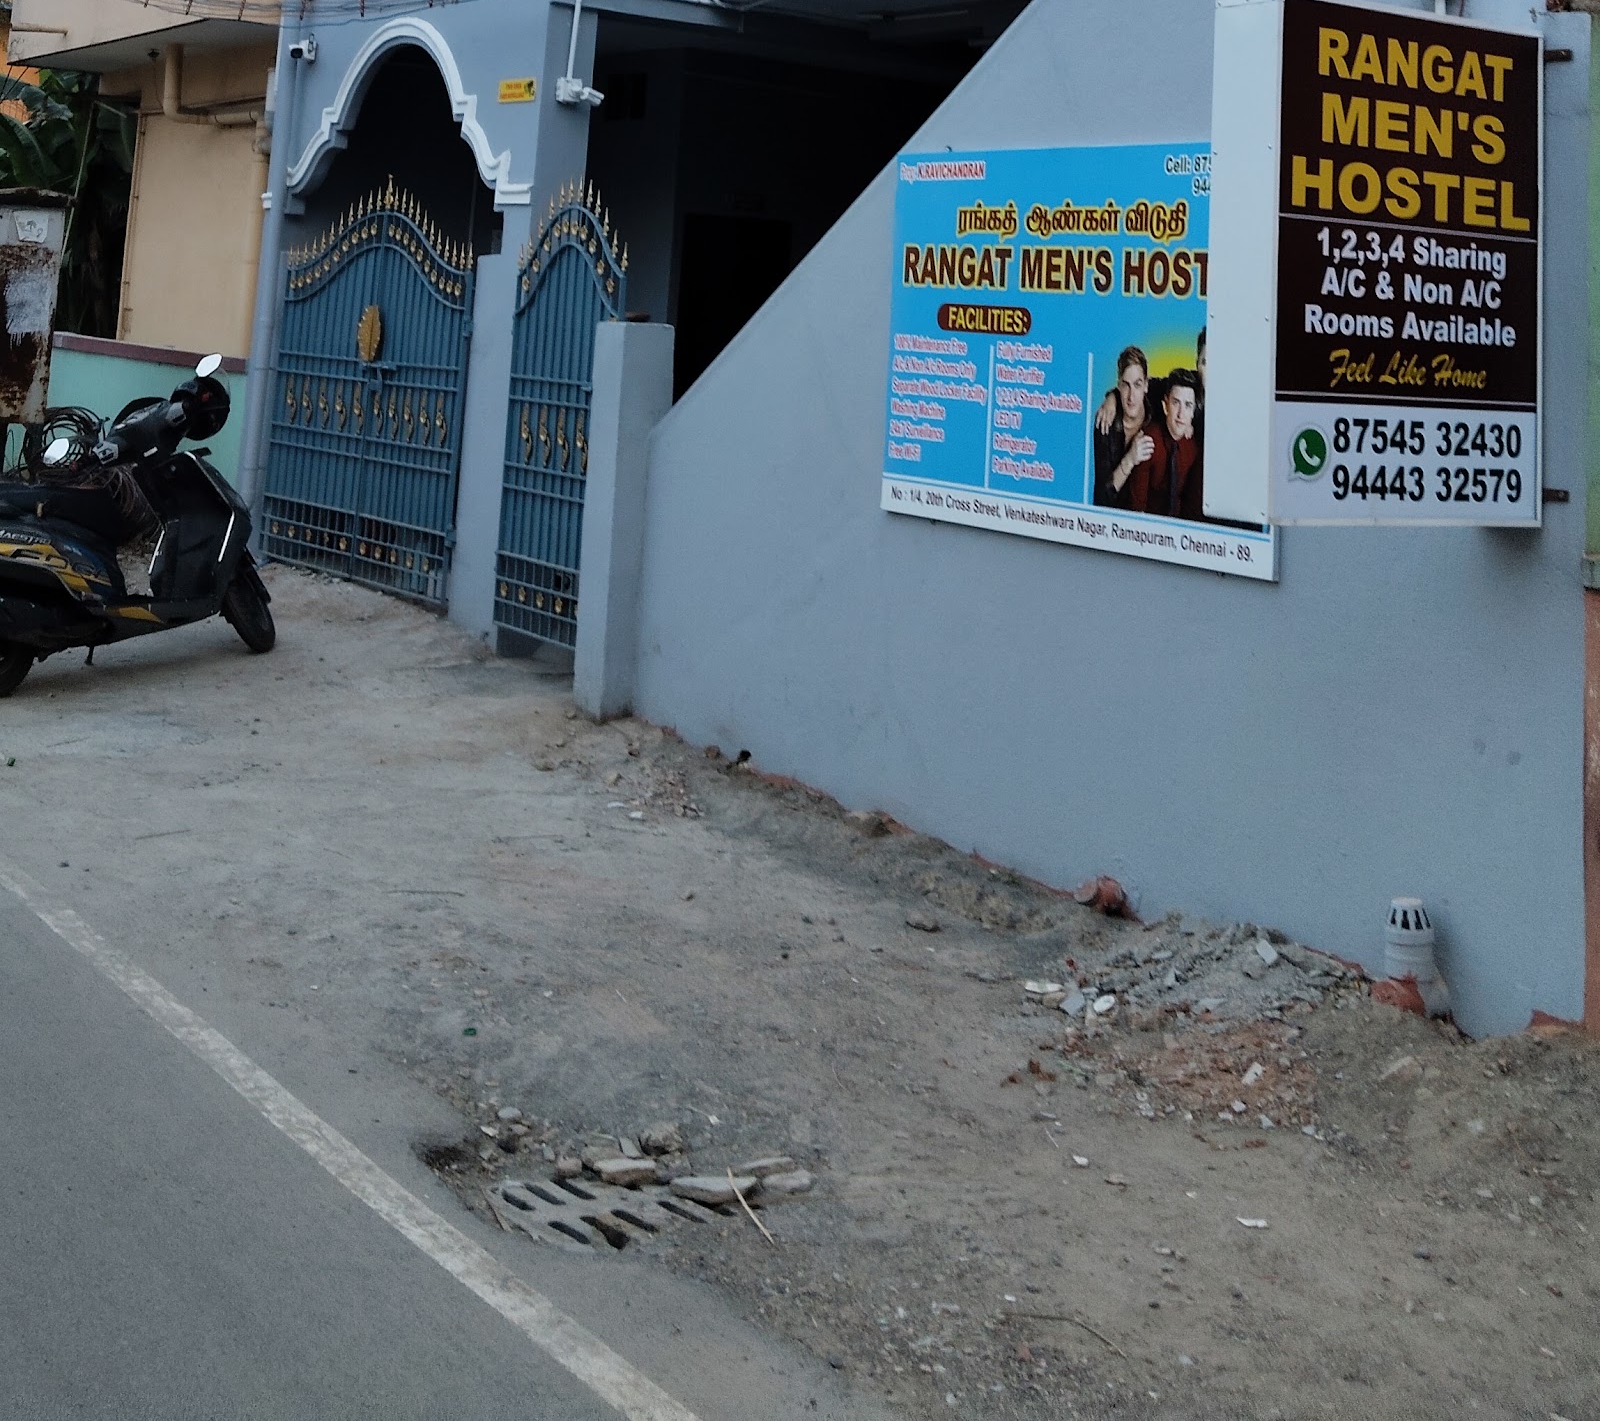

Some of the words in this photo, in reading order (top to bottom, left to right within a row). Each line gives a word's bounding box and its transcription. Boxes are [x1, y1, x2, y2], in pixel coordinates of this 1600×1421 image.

[1318, 27, 1513, 102] RANGAT
[1322, 92, 1506, 165] MEN'S
[1165, 156, 1192, 173] Cell:
[1291, 155, 1530, 231] HOSTEL
[957, 201, 1018, 237] ரங்கத்
[1026, 201, 1121, 237] ஆண்கள்
[1125, 201, 1187, 242] விடுதி
[904, 246, 1012, 287] RANGAT
[1020, 249, 1112, 292] MEN'S
[1317, 227, 1405, 268] 1,2,3,4
[1413, 236, 1507, 280] Sharing
[1321, 267, 1366, 298] A/C
[1375, 271, 1395, 300] &
[1404, 274, 1453, 305] Non
[1460, 279, 1502, 309] A/C
[948, 306, 1028, 333] FACILITIES:
[1305, 304, 1394, 339] Rooms
[1401, 312, 1517, 347] Available
[1329, 349, 1375, 387] Feel
[1379, 350, 1427, 385] Like
[1431, 354, 1487, 389] Home
[1333, 418, 1425, 455] 87545
[1435, 422, 1521, 458] 32430
[1332, 465, 1425, 501] 94443
[1435, 467, 1521, 503] 32579
[926, 490, 944, 508] 20th
[946, 495, 971, 512] Cross
[1004, 504, 1074, 530] Venkateshwara
[1111, 523, 1177, 551] Ramapuram,
[1180, 535, 1226, 558] Chennai
